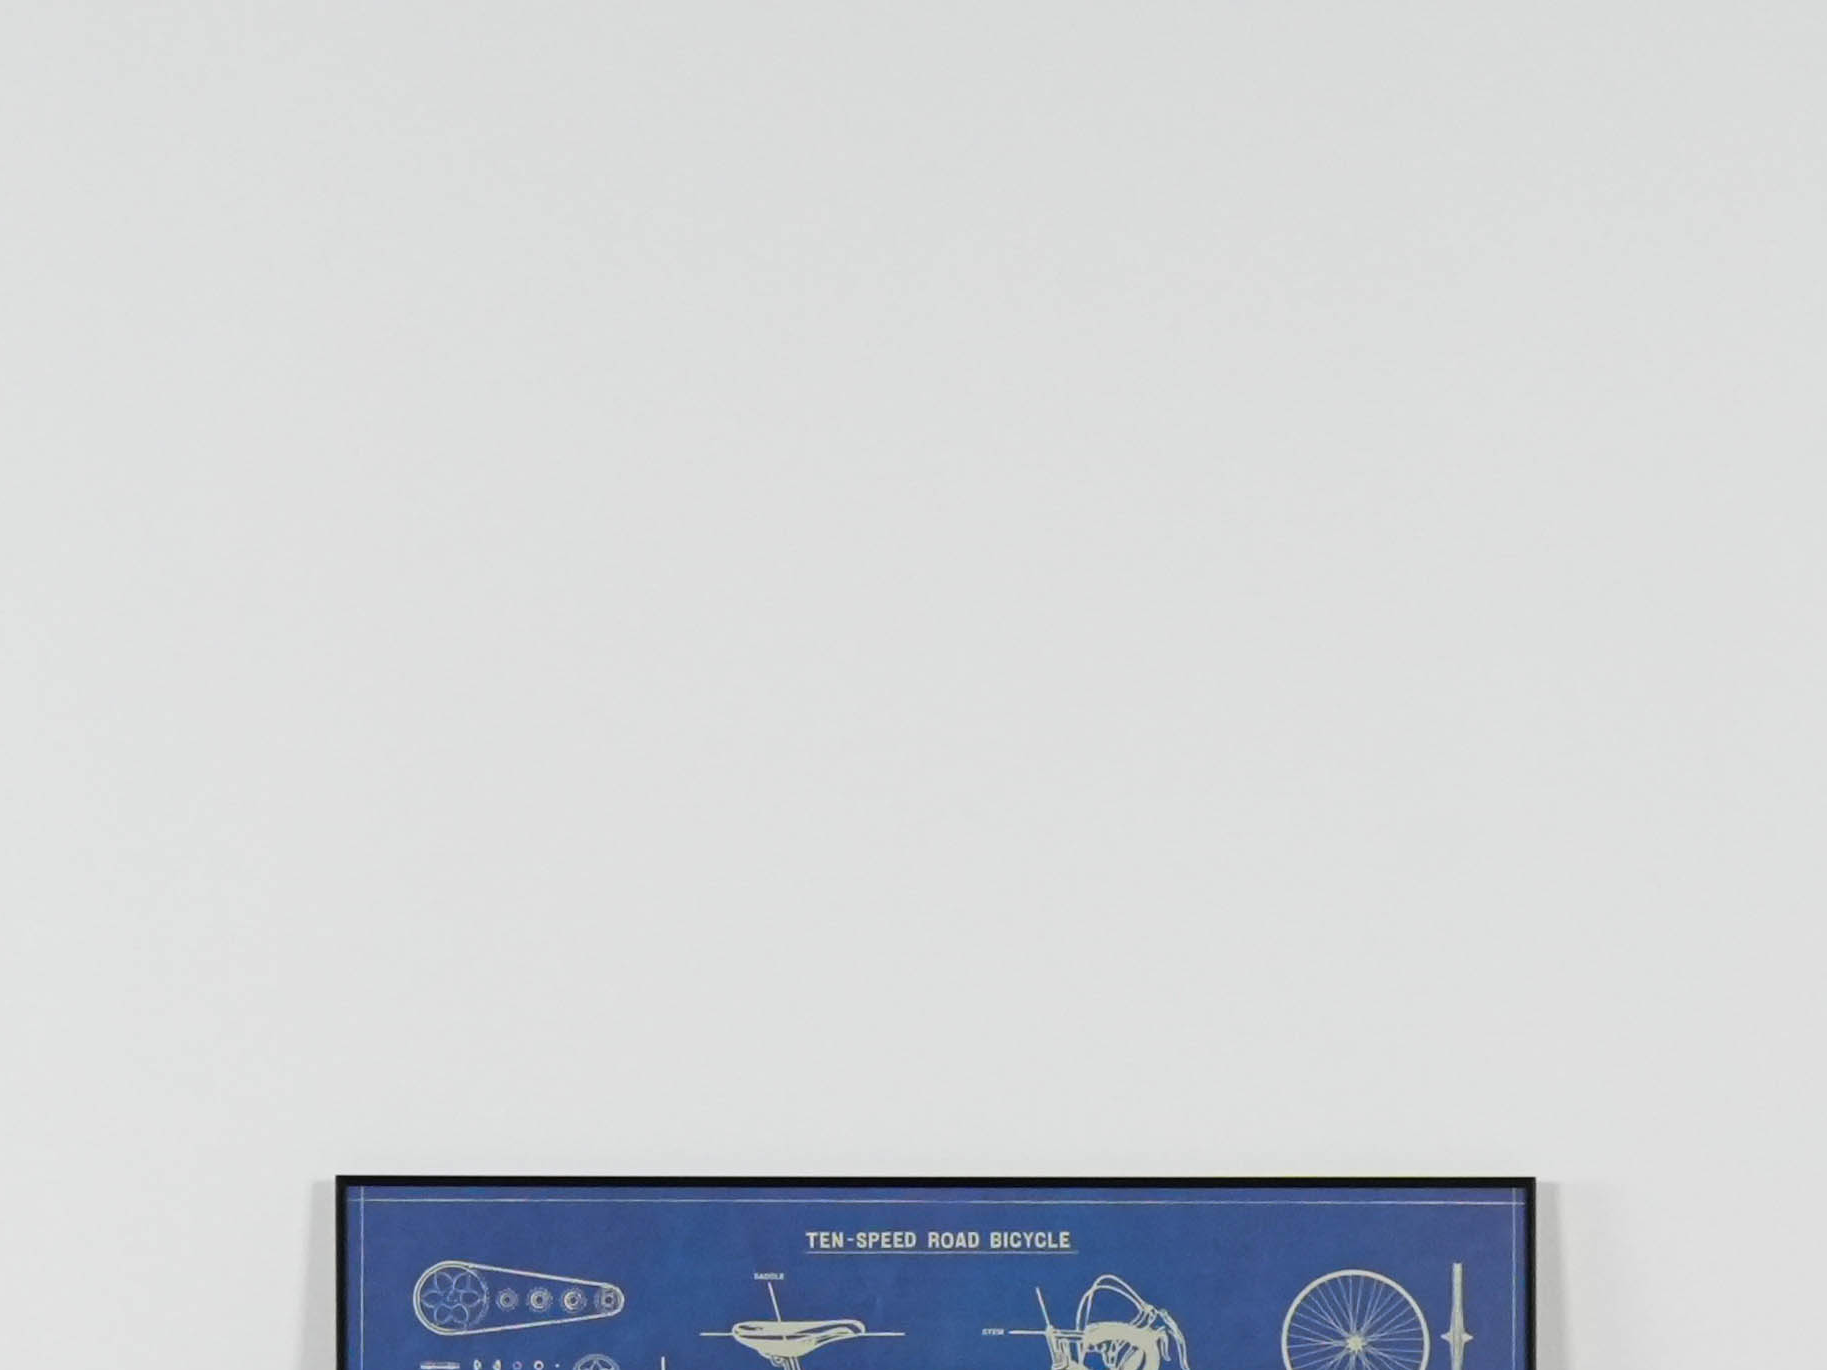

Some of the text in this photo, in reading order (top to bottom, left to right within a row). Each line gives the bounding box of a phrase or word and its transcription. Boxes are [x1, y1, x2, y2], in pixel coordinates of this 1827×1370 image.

[806, 1231, 1071, 1249] TEN-SPEED ROAD BICYCLE
